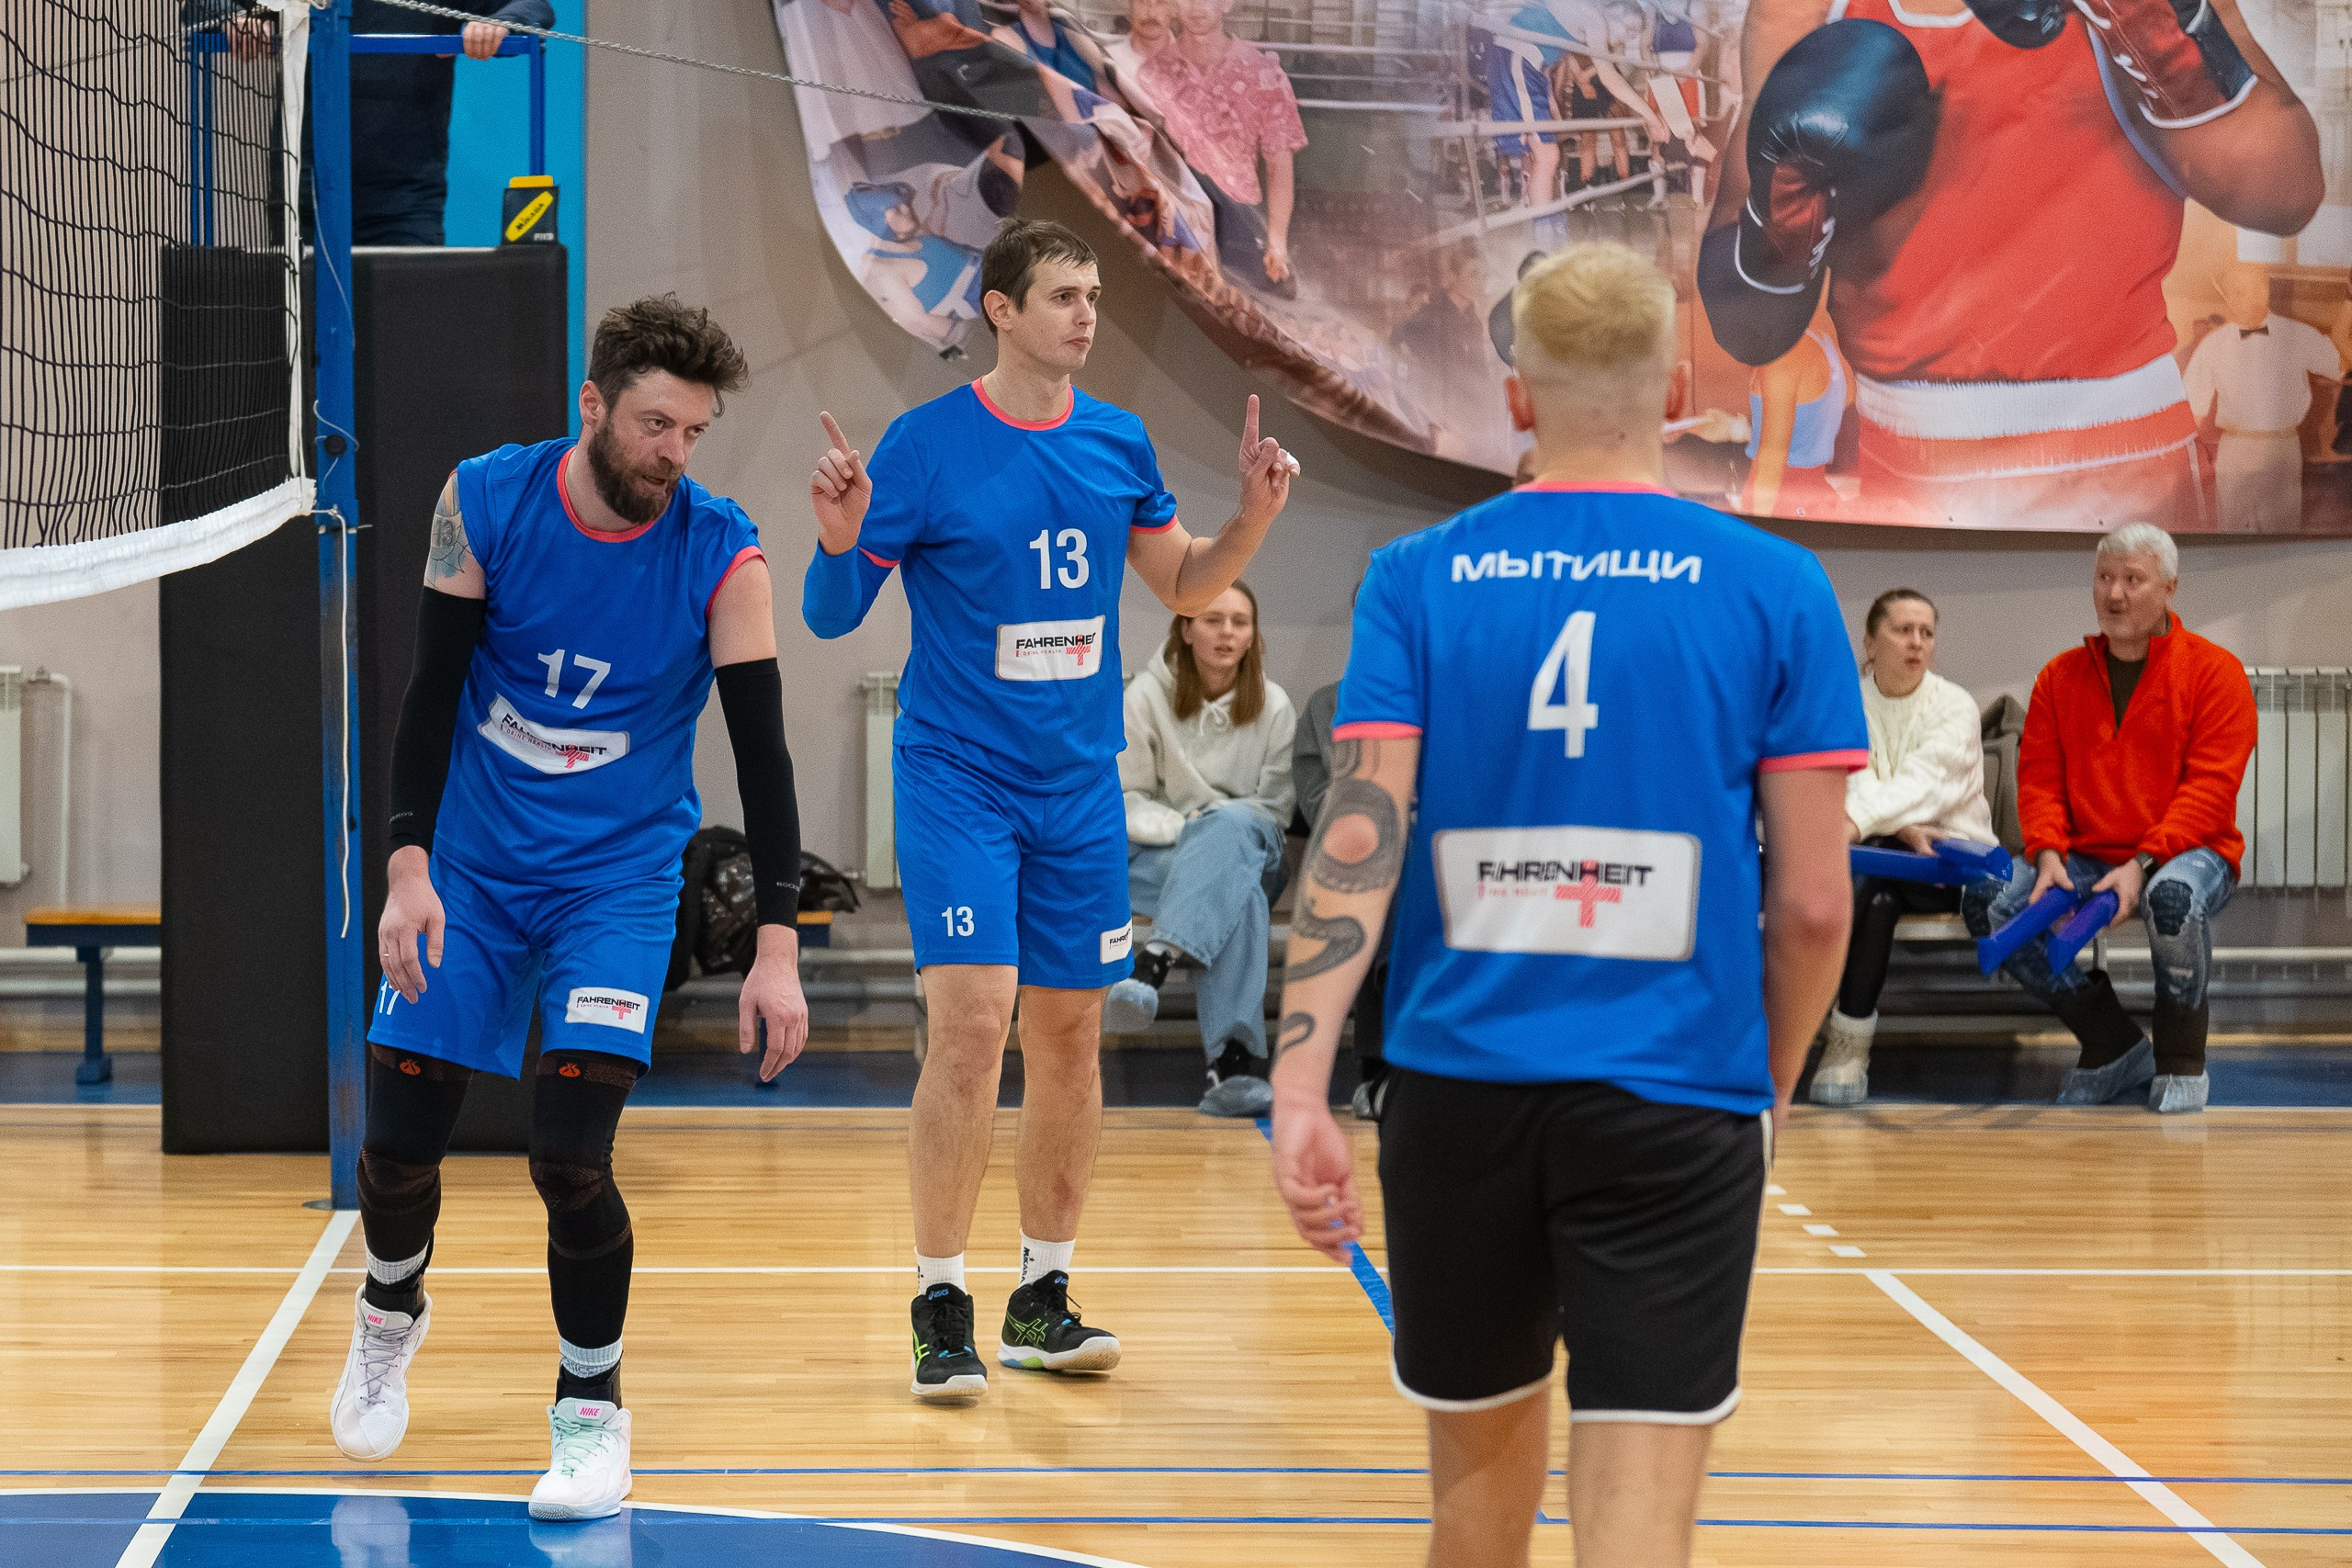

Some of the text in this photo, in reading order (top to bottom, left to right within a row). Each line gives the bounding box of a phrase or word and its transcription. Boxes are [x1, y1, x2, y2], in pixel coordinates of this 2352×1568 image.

[1029, 527, 1091, 590] 13
[1451, 548, 1702, 584] МЫТИЩИ
[537, 649, 612, 710] 17
[1527, 610, 1599, 759] 4
[941, 906, 975, 937] 13
[379, 980, 401, 1016] 17
[577, 997, 641, 1010] FAHRENHEIT
[368, 1314, 383, 1325] NIKE
[579, 1406, 600, 1416] NIKE
